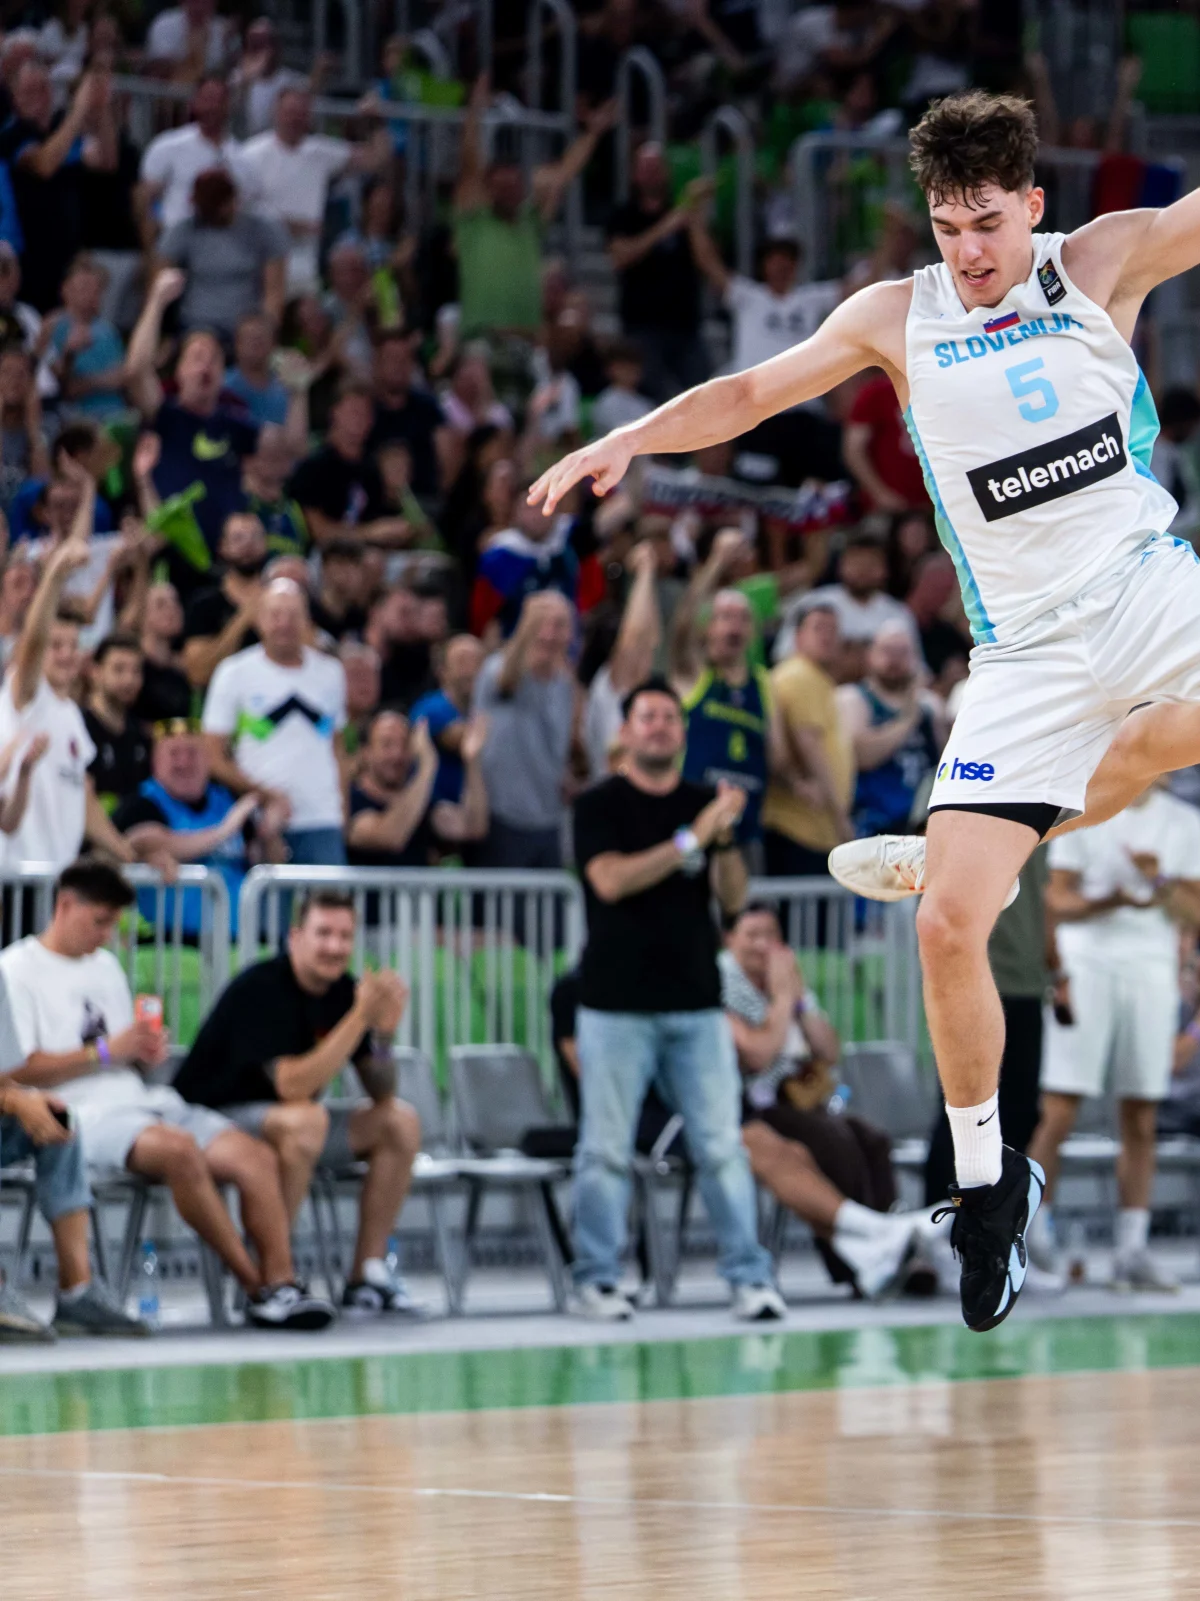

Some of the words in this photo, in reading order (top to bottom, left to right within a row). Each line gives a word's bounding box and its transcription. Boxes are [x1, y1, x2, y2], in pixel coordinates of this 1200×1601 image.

[1046, 281, 1062, 297] FIBA
[933, 312, 1085, 369] SLOVENIJA
[1004, 356, 1060, 424] 5
[987, 432, 1121, 503] telemach
[950, 757, 995, 782] hse
